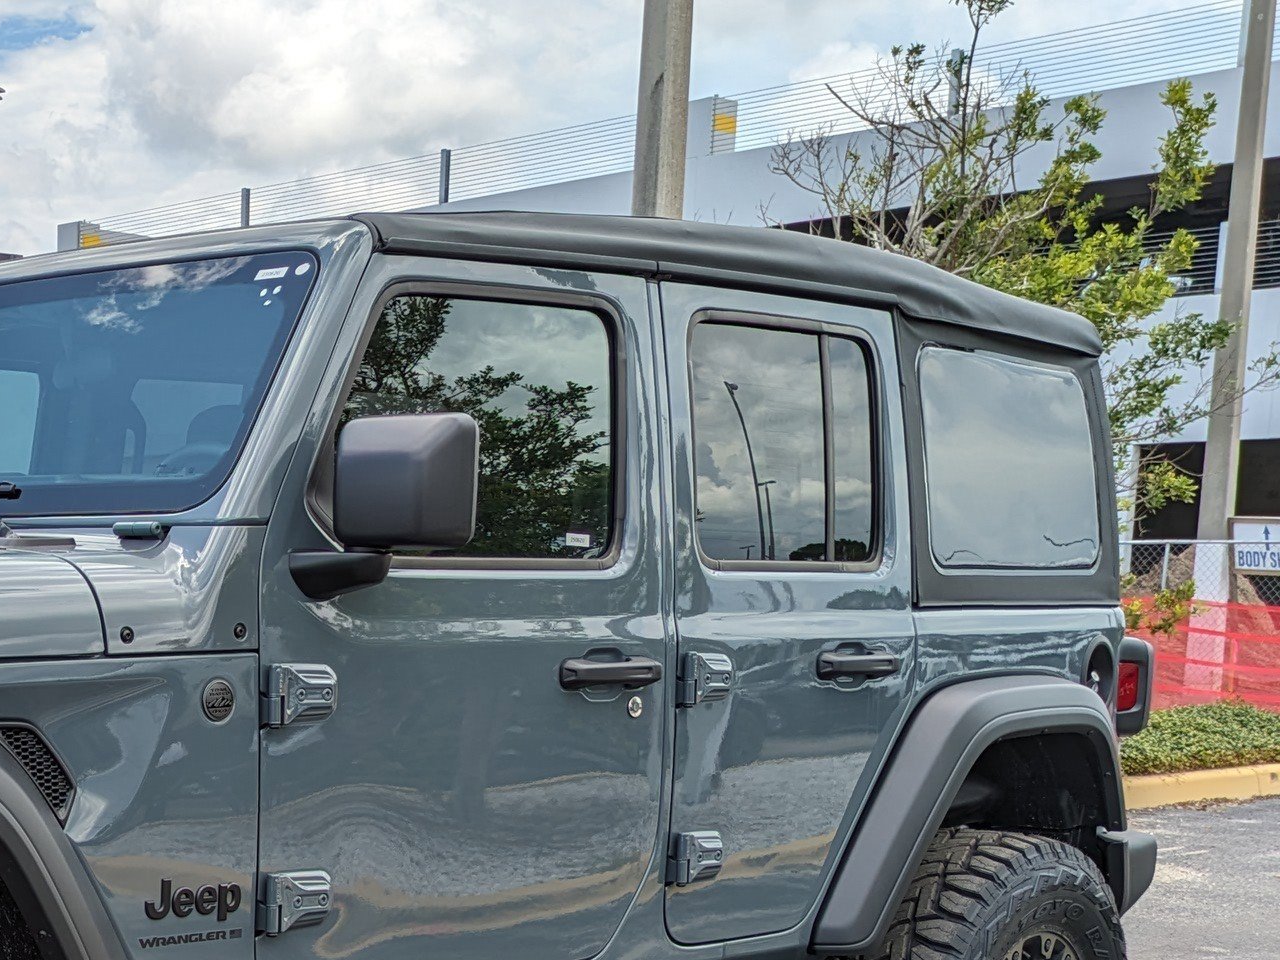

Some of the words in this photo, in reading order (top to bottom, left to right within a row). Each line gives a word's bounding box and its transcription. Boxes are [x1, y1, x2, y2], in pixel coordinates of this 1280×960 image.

[1238, 550, 1267, 568] BODY
[144, 878, 241, 922] Jeep
[138, 930, 227, 949] WRANGLER
